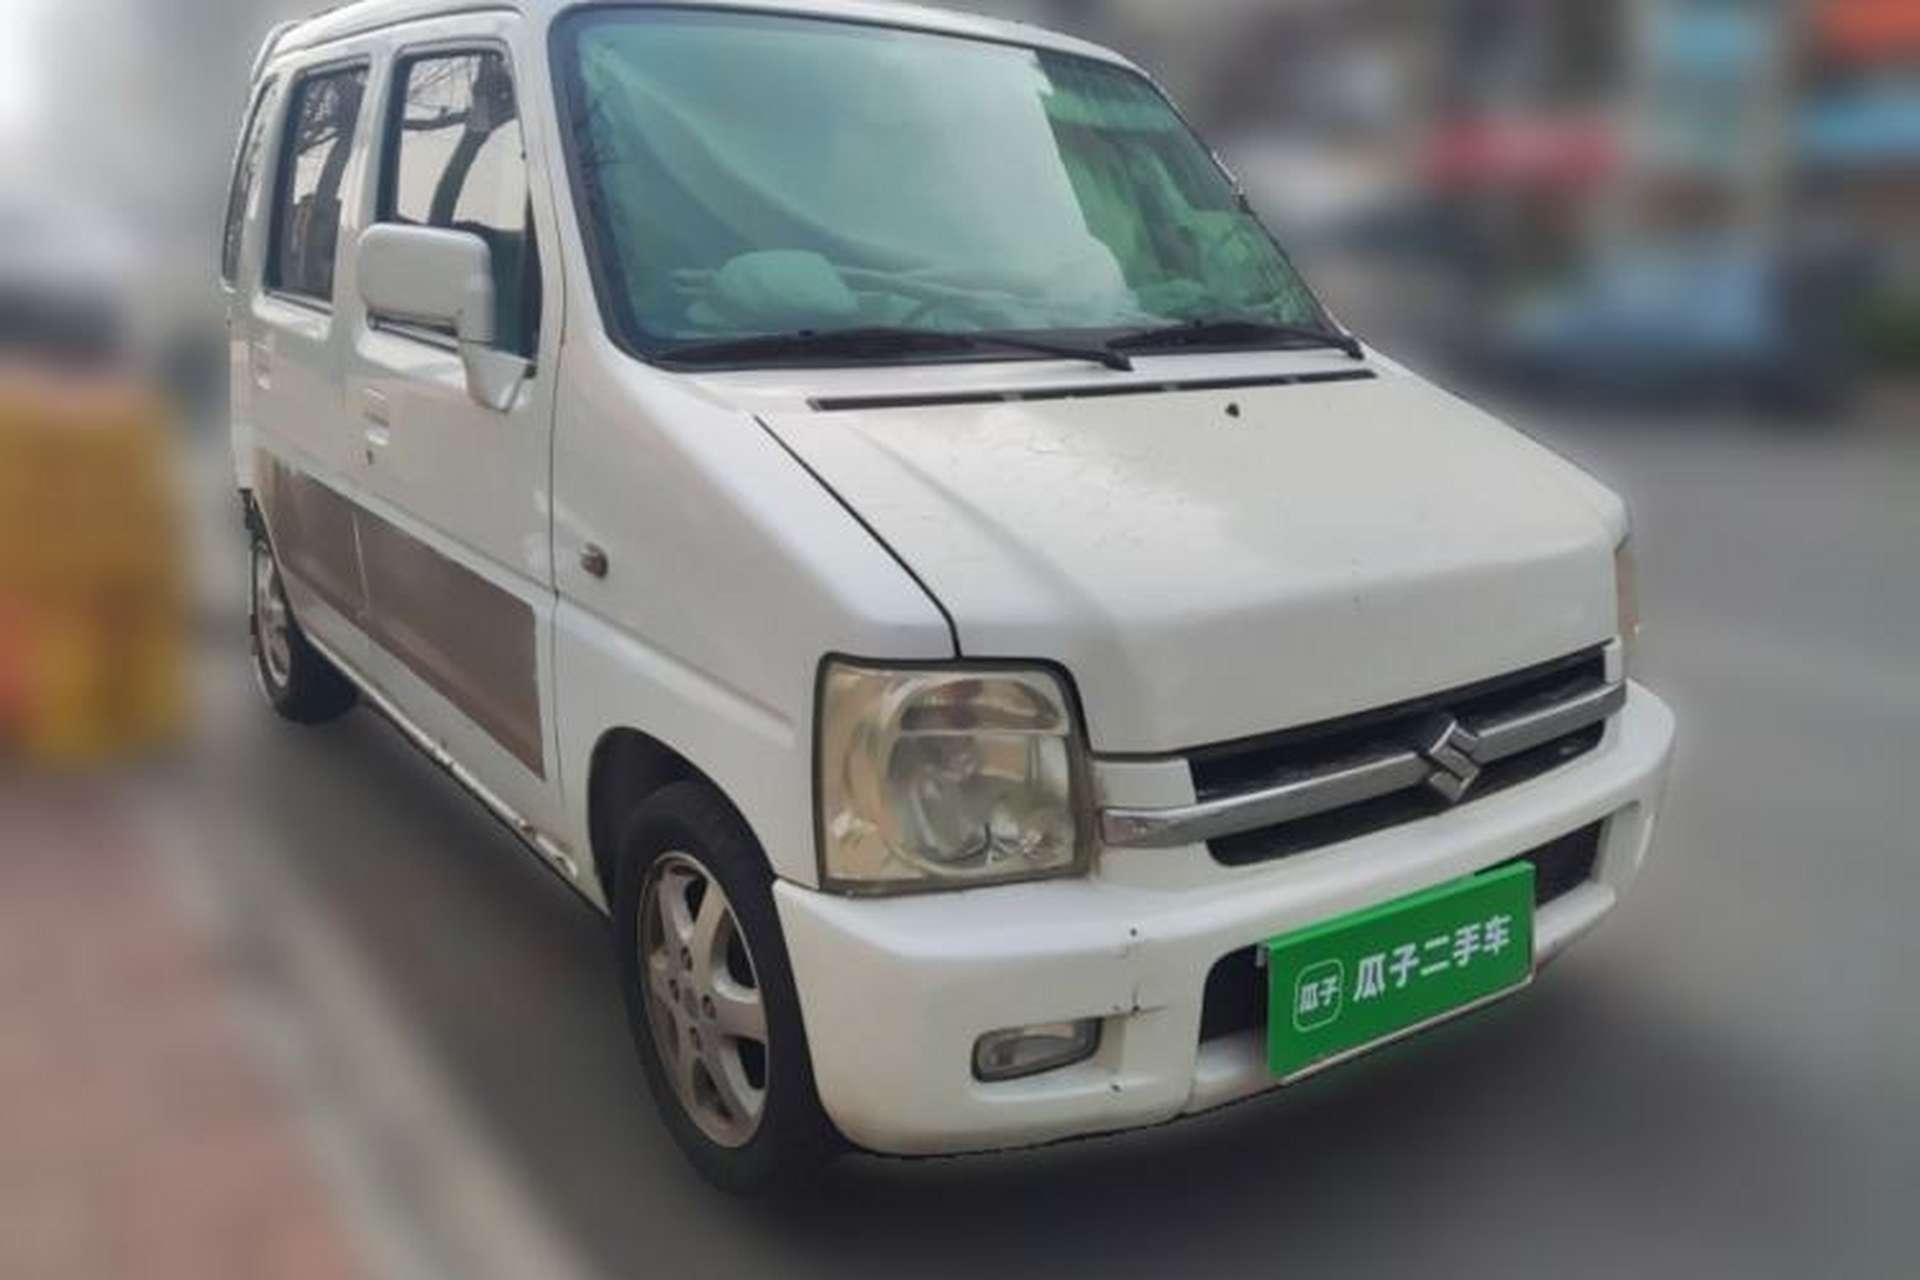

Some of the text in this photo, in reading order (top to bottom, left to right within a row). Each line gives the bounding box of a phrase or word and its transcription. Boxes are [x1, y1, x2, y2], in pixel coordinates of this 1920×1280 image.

[1353, 915, 1511, 1002] 瓜子二手车
[1300, 976, 1338, 1013] 瓜子
